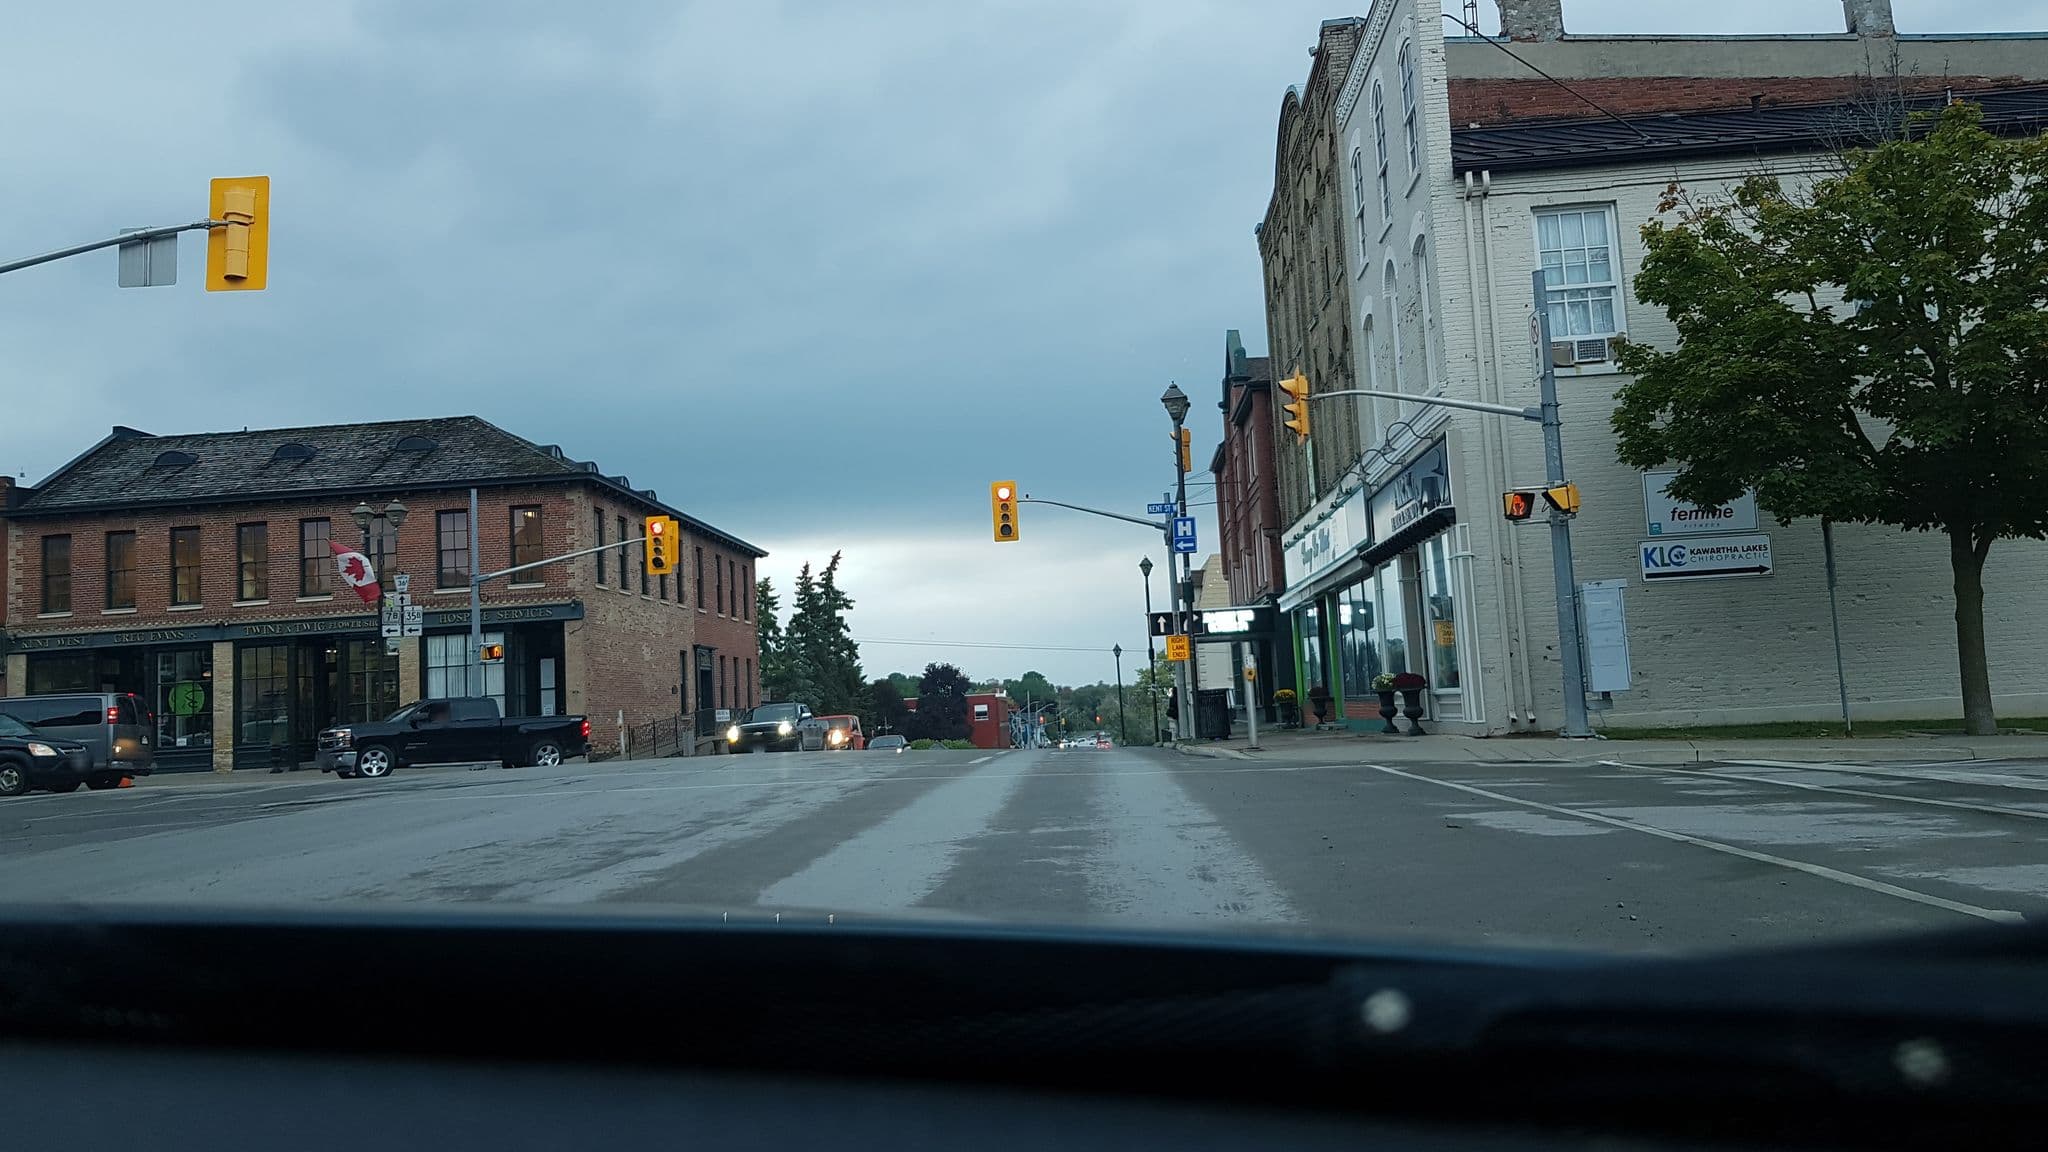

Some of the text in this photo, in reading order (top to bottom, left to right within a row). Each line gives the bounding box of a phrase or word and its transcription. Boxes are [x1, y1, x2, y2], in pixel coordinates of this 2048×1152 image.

[1148, 504, 1163, 513] KENT
[1177, 520, 1192, 537] H
[1643, 543, 1768, 568] KLC KAWARTHA LAKES
[1689, 552, 1769, 563] CHIROPRACTIC
[439, 607, 553, 623] HOSPE SERVICES
[150, 629, 184, 641] EVANS
[243, 623, 283, 635] TWINE
[294, 621, 325, 632] TWIG
